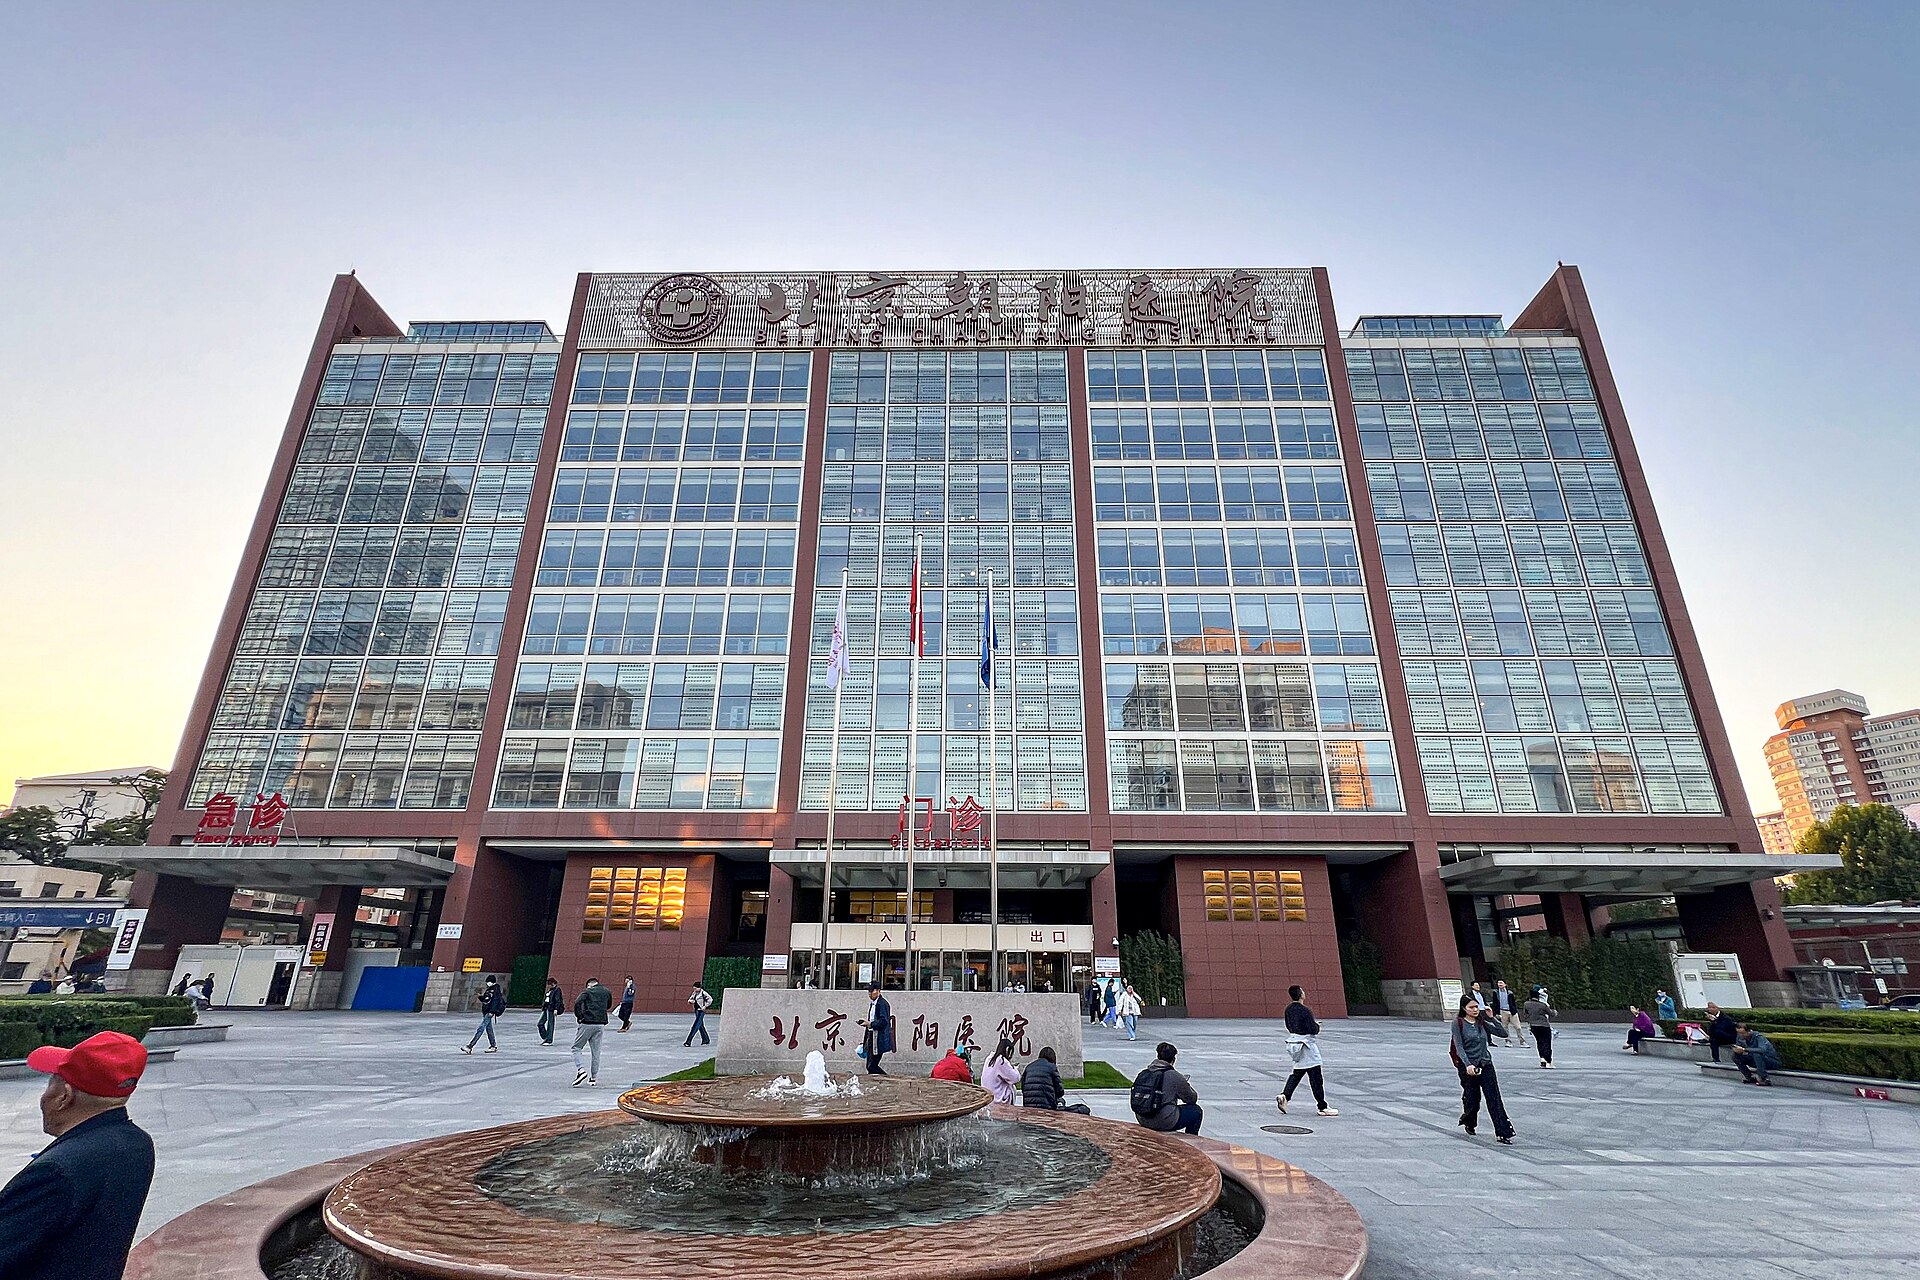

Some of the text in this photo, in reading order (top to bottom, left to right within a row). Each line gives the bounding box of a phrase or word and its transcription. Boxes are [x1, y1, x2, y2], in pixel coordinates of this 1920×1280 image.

[758, 269, 1272, 326] 北京朝阳医院
[754, 328, 883, 343] BEIJING
[1121, 325, 1278, 341] HOSPITAL
[198, 792, 289, 829] 急诊
[900, 795, 984, 832] 门诊
[193, 831, 280, 847] Emergency
[890, 834, 991, 848] Outpatient
[96, 913, 111, 924] B1
[880, 930, 916, 943] 入口
[1030, 930, 1066, 943] 出口
[769, 1008, 1032, 1057] 北京阳医院
